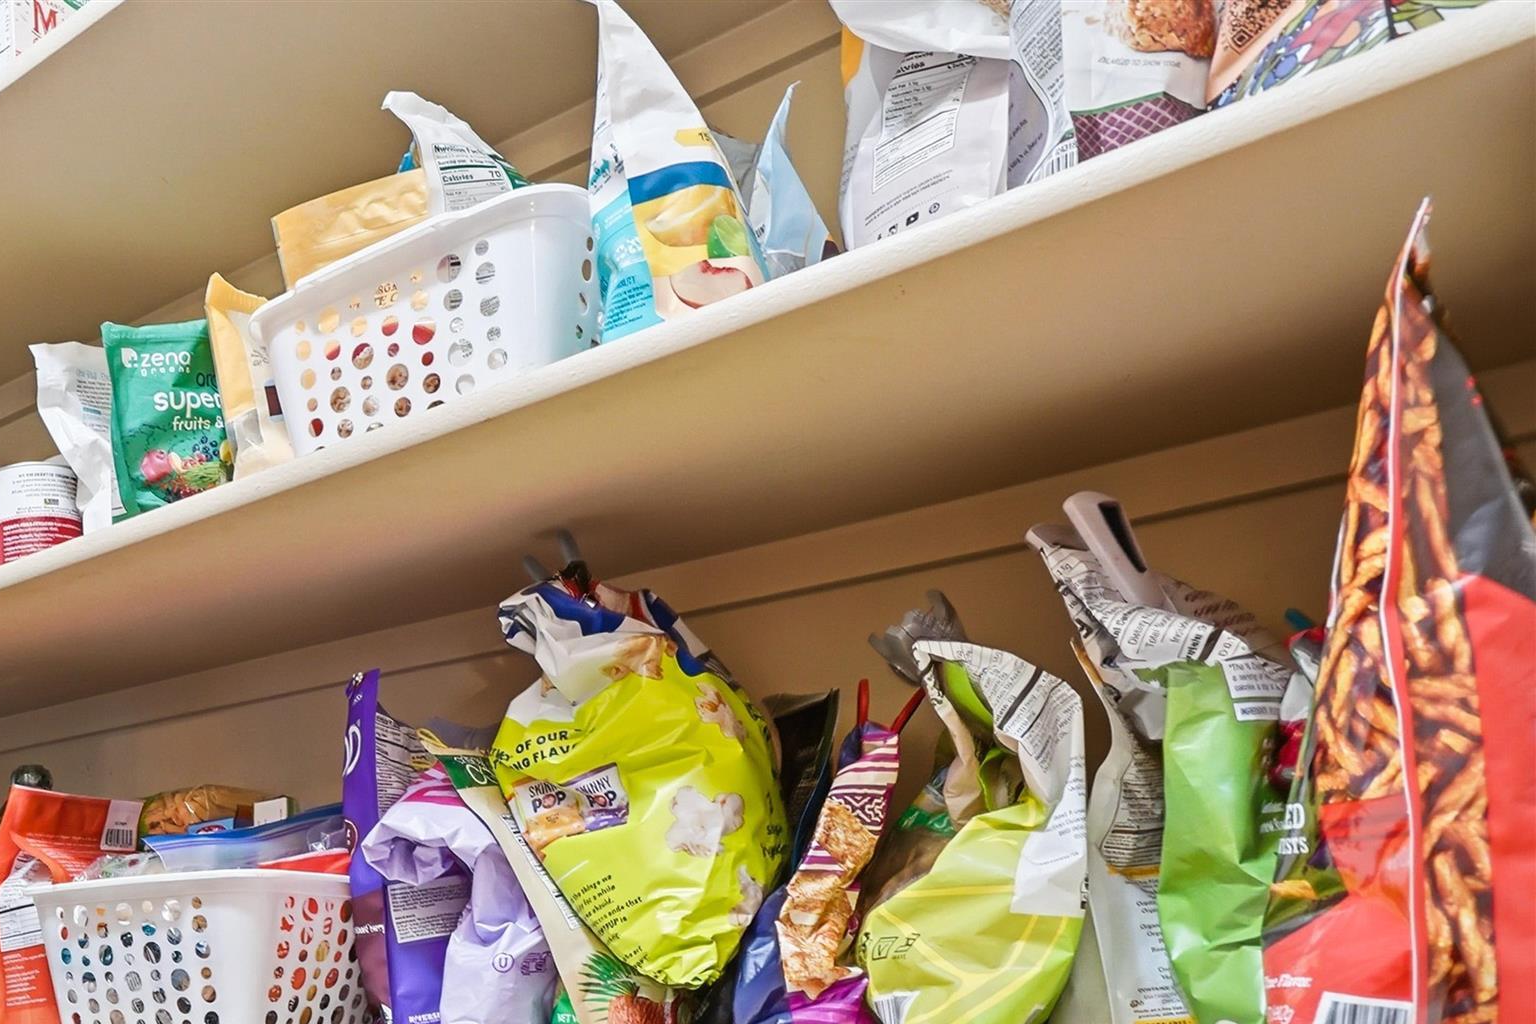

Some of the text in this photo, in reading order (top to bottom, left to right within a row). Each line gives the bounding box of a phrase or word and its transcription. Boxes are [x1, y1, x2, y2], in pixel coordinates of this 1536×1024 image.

[442, 170, 502, 183] Calories 70
[140, 350, 191, 367] zeno
[172, 416, 211, 432] fruits
[515, 730, 569, 754] OF OUR
[531, 790, 567, 813] POP
[586, 790, 617, 808] POP
